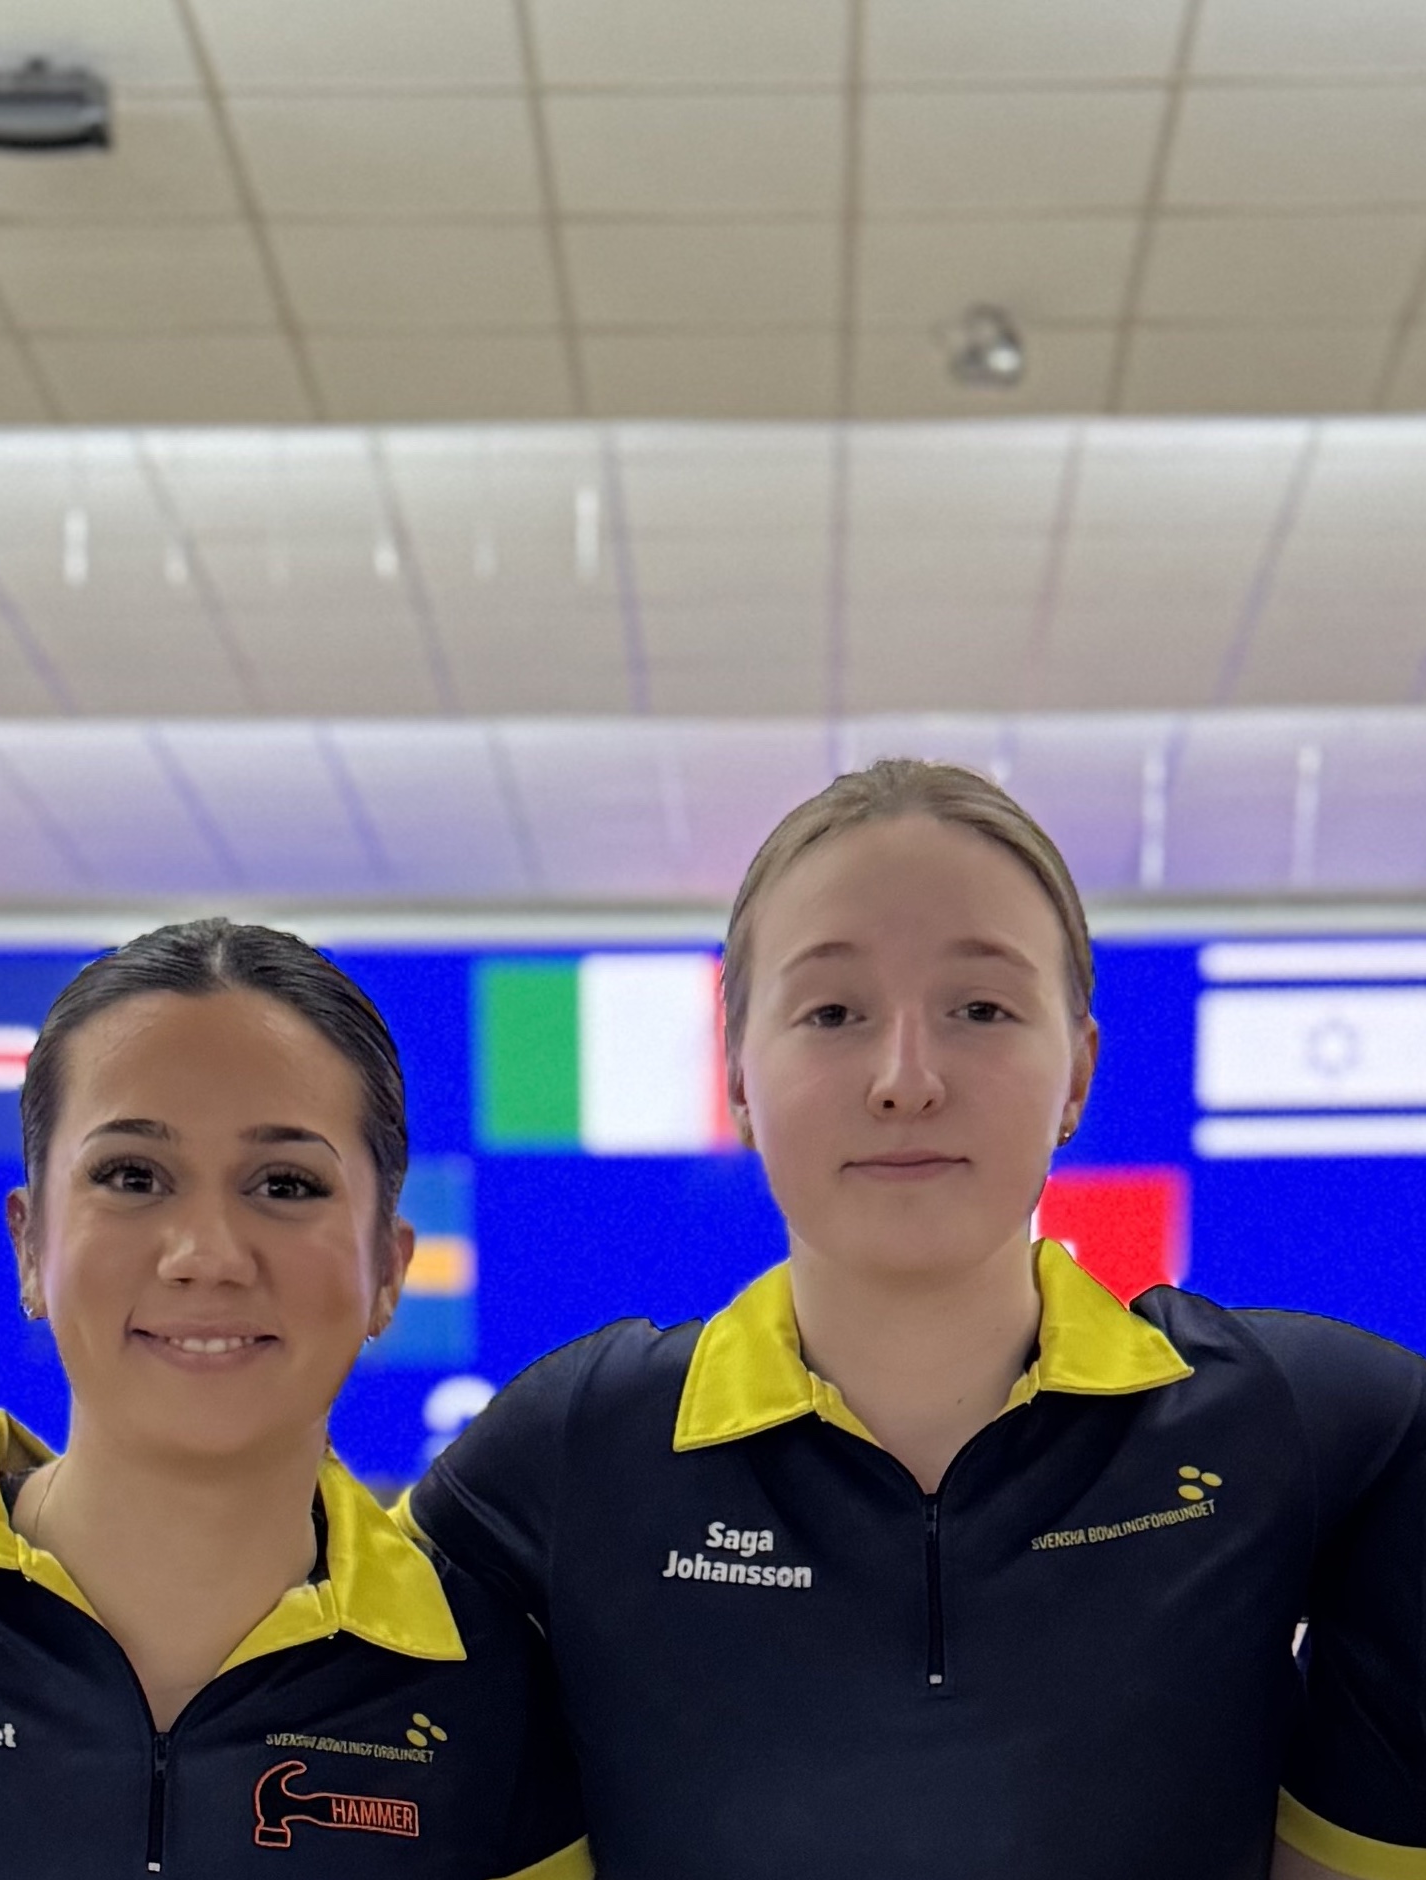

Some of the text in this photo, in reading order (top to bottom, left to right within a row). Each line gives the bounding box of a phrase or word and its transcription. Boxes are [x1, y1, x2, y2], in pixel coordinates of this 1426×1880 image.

[705, 1521, 774, 1558] Saga
[662, 1550, 812, 1588] Johansson
[330, 1798, 414, 1831] HAMMER
